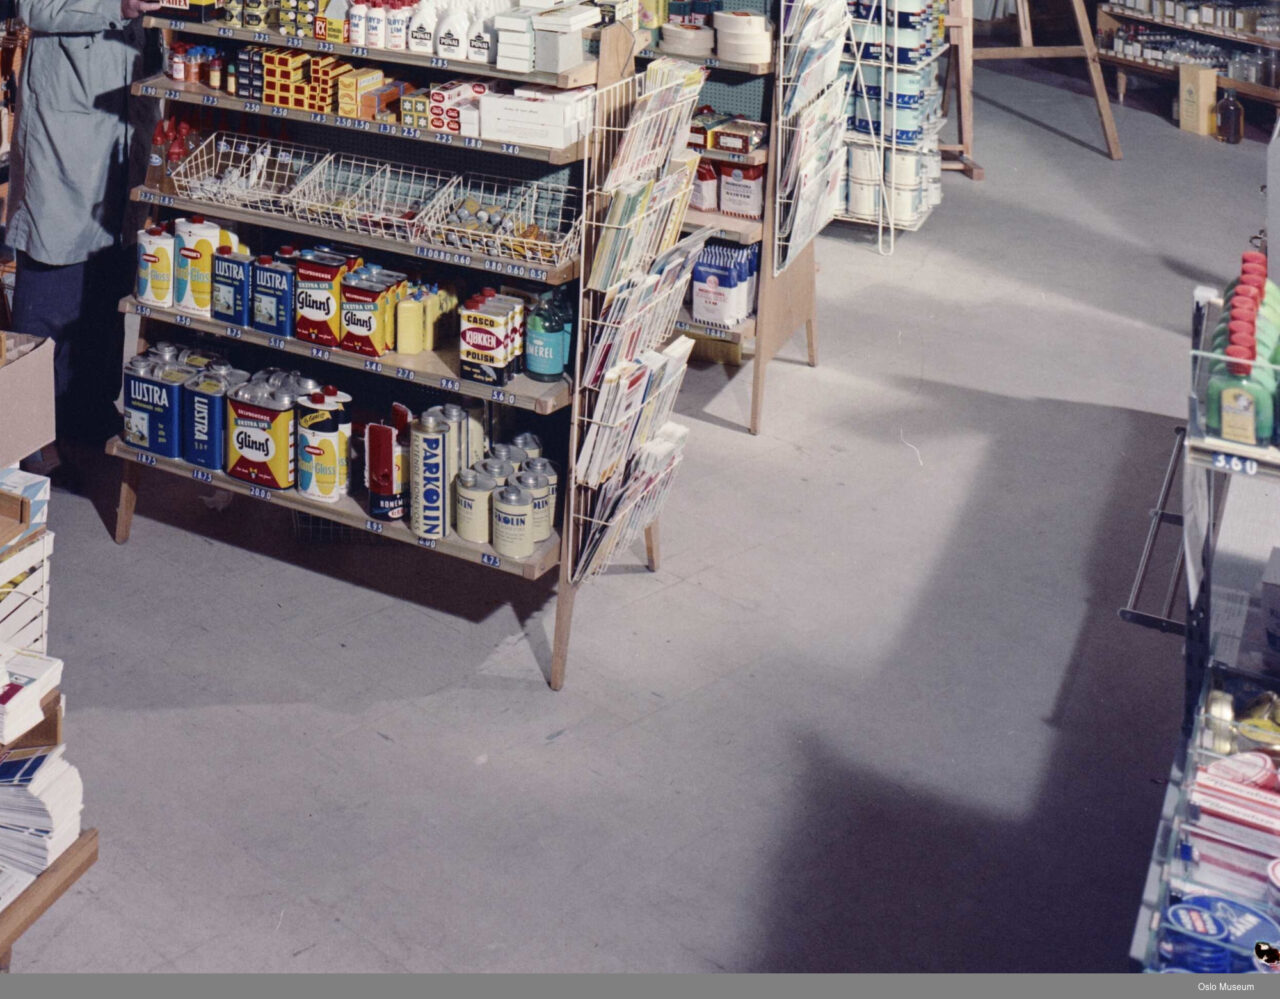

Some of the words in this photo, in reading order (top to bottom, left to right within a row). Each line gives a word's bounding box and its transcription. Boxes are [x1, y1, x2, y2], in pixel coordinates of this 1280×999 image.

[315, 21, 326, 34] RX
[431, 59, 448, 68] 2.85
[246, 104, 259, 112] 2.50
[273, 108, 287, 116] 2.50
[336, 118, 351, 127] 2.50
[355, 121, 369, 130] 1.50
[381, 125, 396, 134] 1.30
[403, 128, 420, 137] 2.50
[436, 135, 452, 143] 2.25
[465, 139, 482, 148] 1.80
[503, 145, 519, 154] 3.40
[454, 253, 470, 262] 0.60
[215, 260, 244, 280] LUSTRA
[485, 261, 502, 272] 0.80
[508, 265, 524, 276] 0.60
[256, 270, 288, 290] LUSTRA
[530, 269, 546, 280] 0.50
[297, 290, 330, 315] Glinns
[345, 311, 372, 331] Glinns
[467, 316, 494, 327] CASCO
[312, 349, 329, 360] 9.40
[466, 351, 494, 364] POLISH
[365, 361, 382, 371] 5.40
[397, 369, 414, 379] 2.70
[441, 380, 459, 391] 9.60
[130, 380, 169, 408] LUSTRA
[493, 391, 515, 403] 5.60
[194, 397, 209, 441] LUSTRA
[236, 431, 270, 456] Glinns
[423, 437, 439, 535] PARKOLIN
[251, 488, 271, 499] 20.00
[483, 557, 500, 566] 4.75
